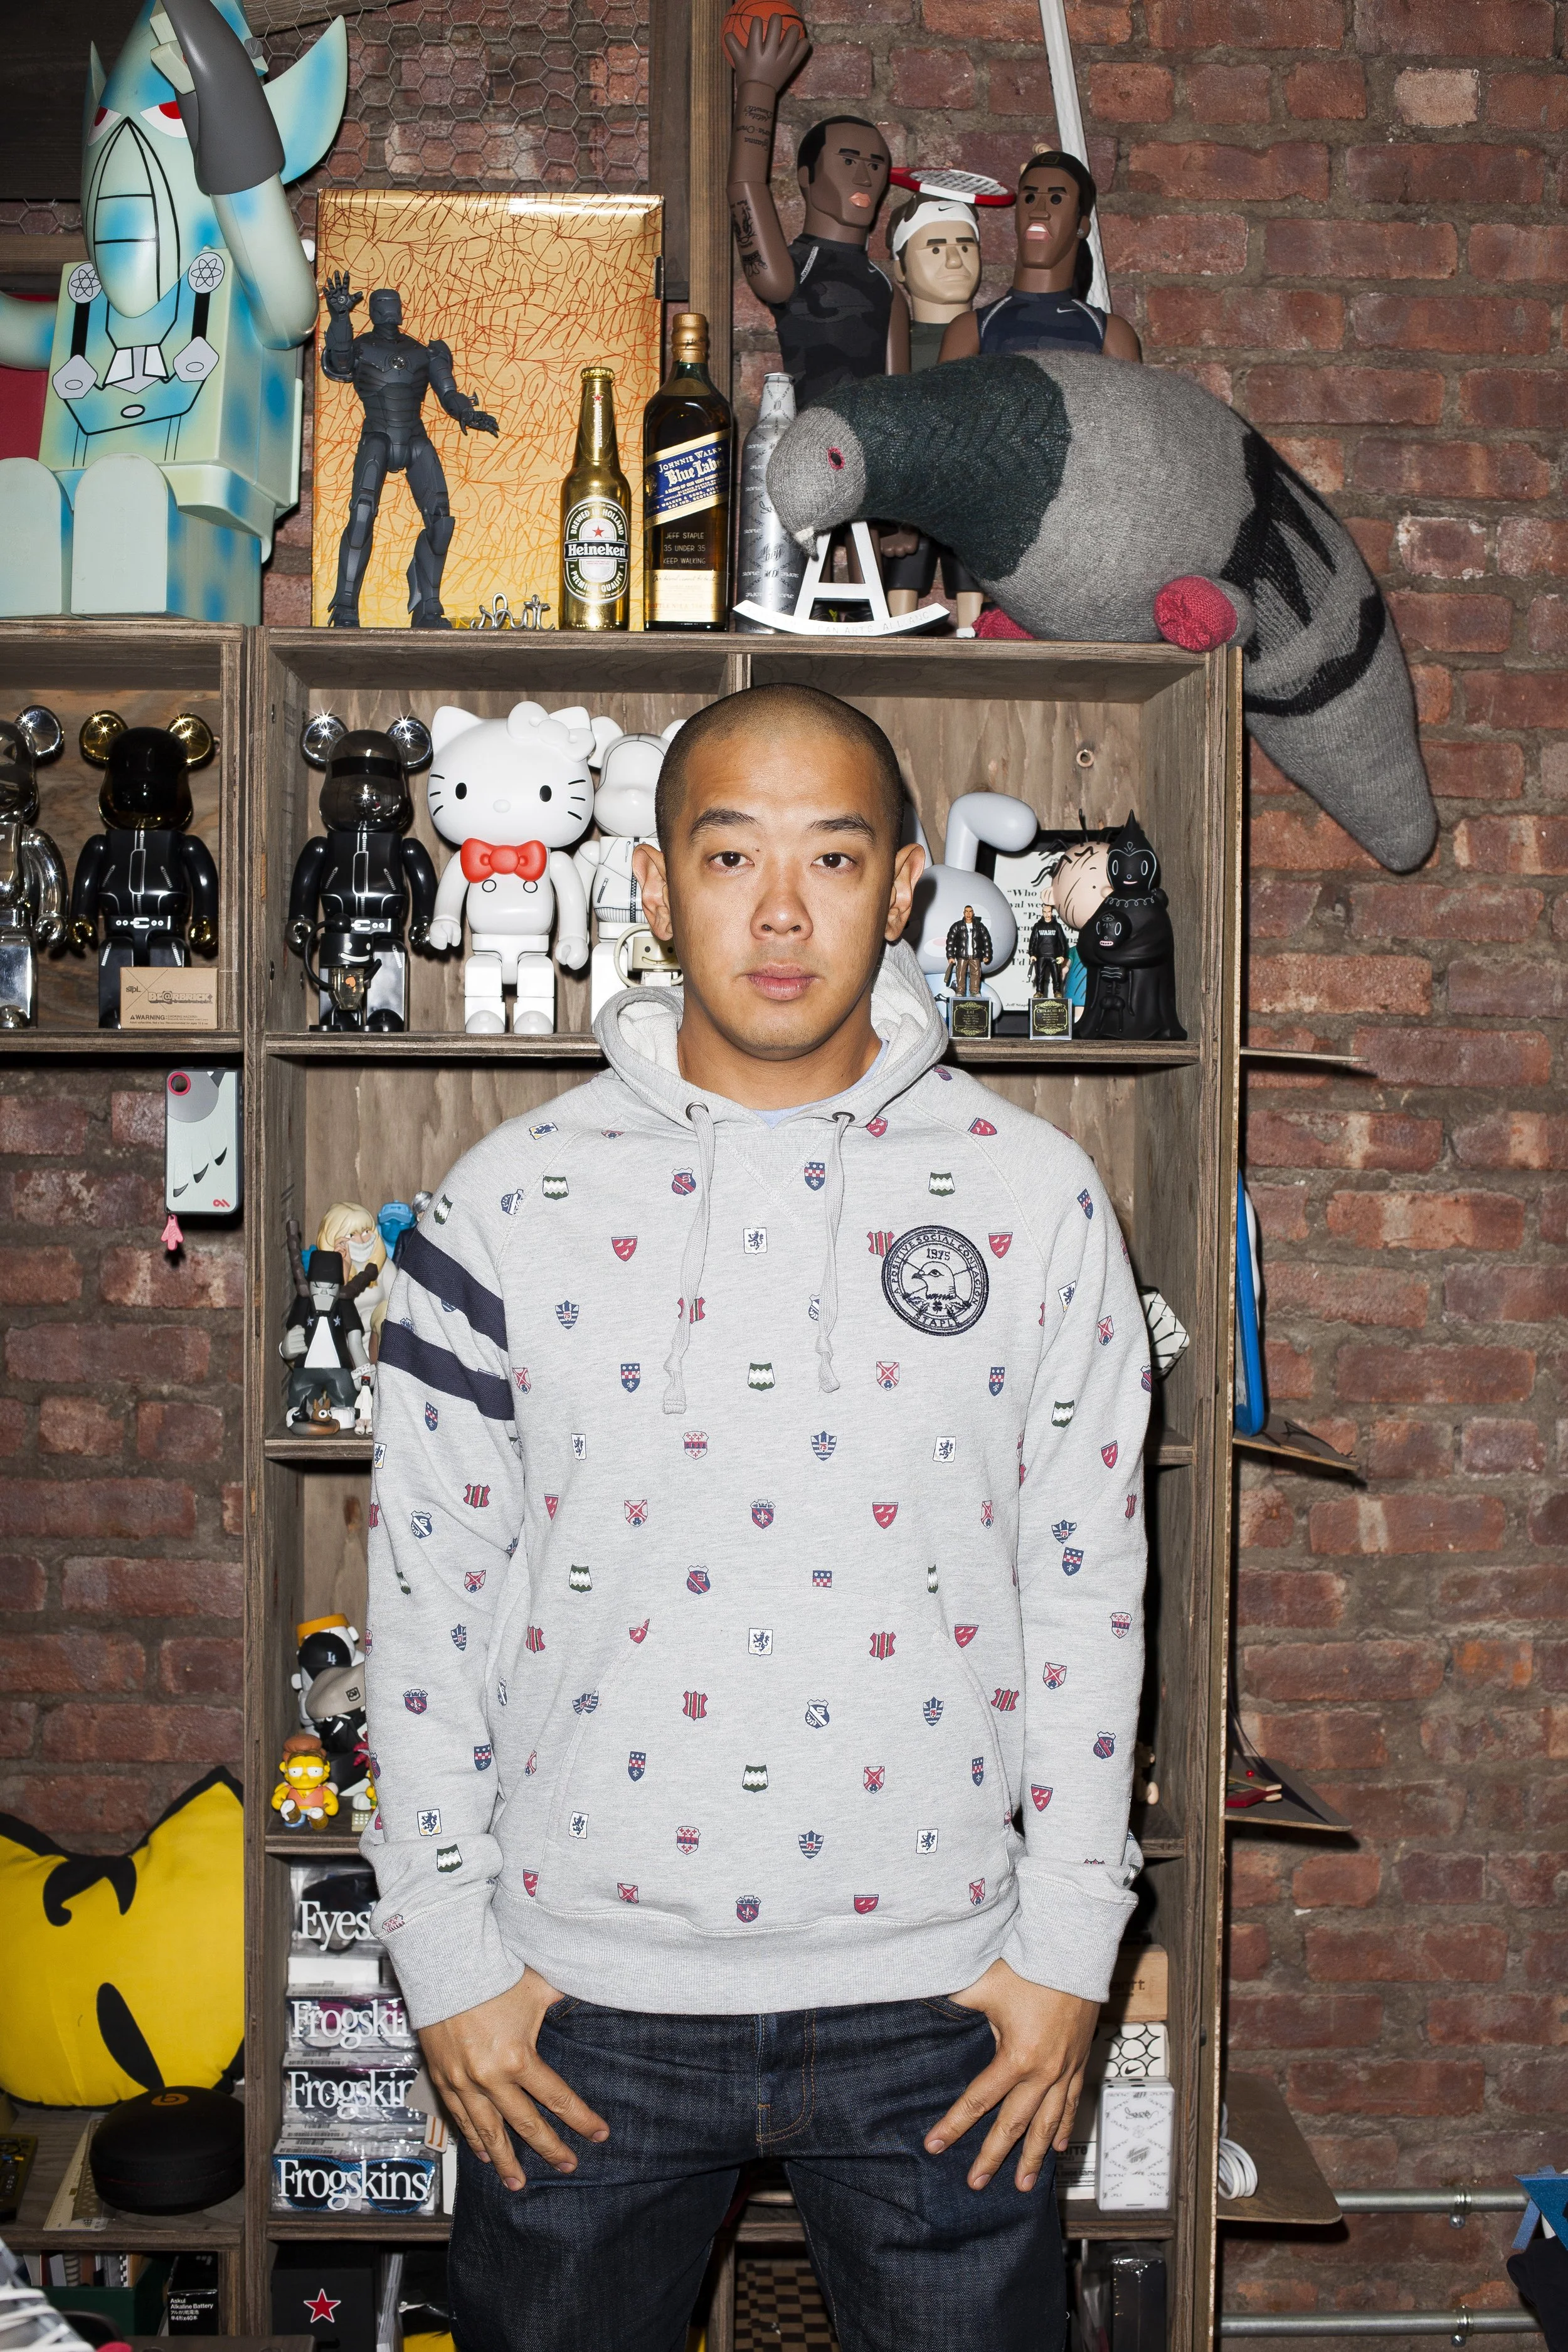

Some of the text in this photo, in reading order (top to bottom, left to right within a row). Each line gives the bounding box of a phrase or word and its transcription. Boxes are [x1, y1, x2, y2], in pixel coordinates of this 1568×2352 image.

[659, 455, 694, 473] JOHNNIE
[664, 467, 696, 487] Blue
[570, 510, 590, 534] BREWED
[602, 509, 625, 535] HOLLAND
[568, 543, 626, 557] Heineken
[571, 570, 623, 592] PREMI QUALITY
[916, 1234, 955, 1246] SOCIAL
[891, 1241, 914, 1283] POSITIVE
[926, 1248, 951, 1260] 1975
[894, 1287, 901, 1295] A
[299, 1901, 378, 1951] Eyes
[278, 2159, 428, 2211] Frogskins
